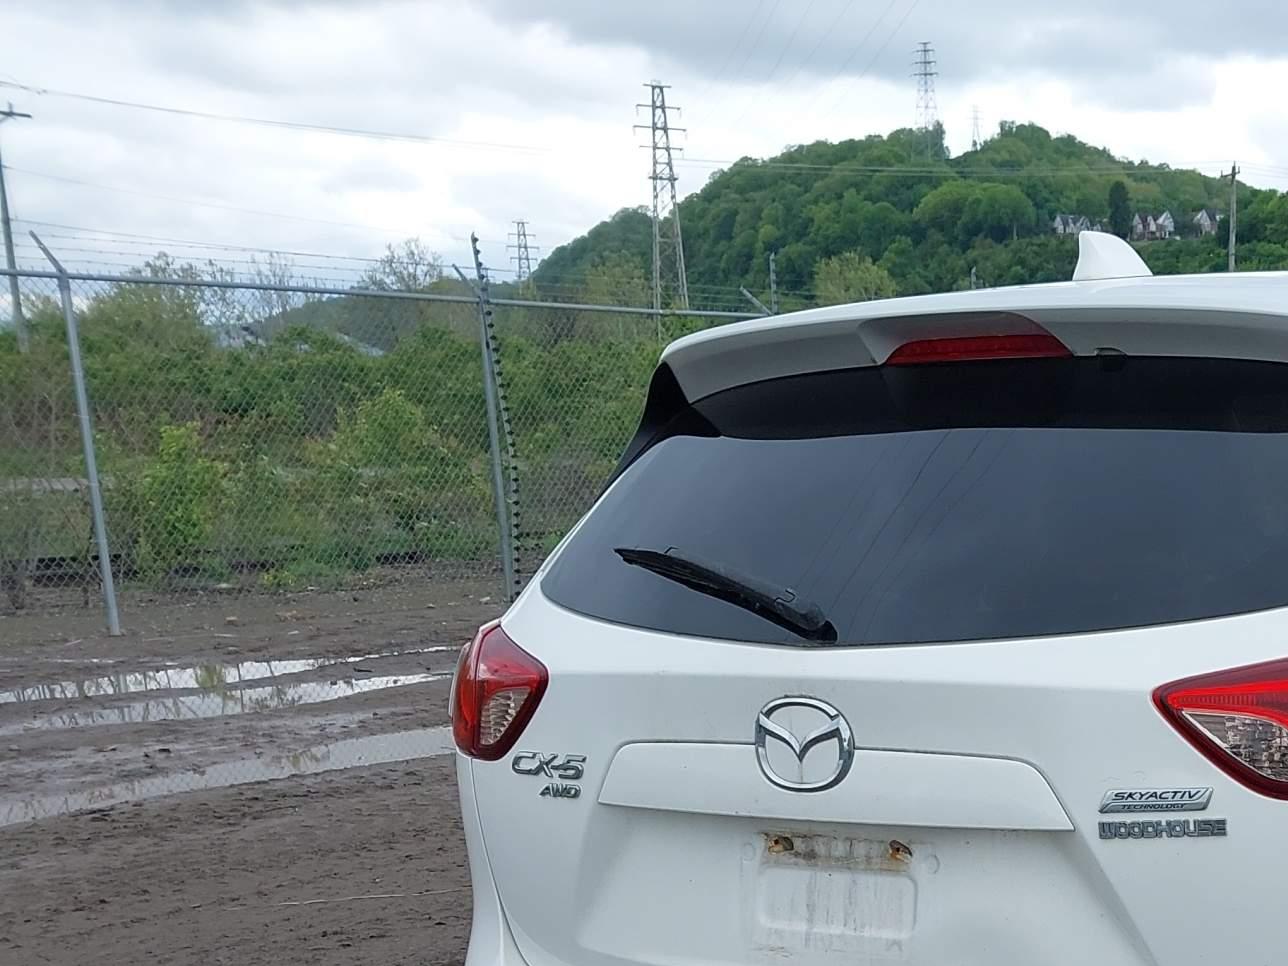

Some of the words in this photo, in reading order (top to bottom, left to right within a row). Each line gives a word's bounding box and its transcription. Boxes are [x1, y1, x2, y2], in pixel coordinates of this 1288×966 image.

[512, 751, 587, 780] CX-5
[539, 783, 582, 798] AWD
[1112, 790, 1201, 801] SKYACTIV
[1121, 802, 1186, 810] TECHNOLOGY
[1098, 819, 1227, 839] WOODHOUSE
